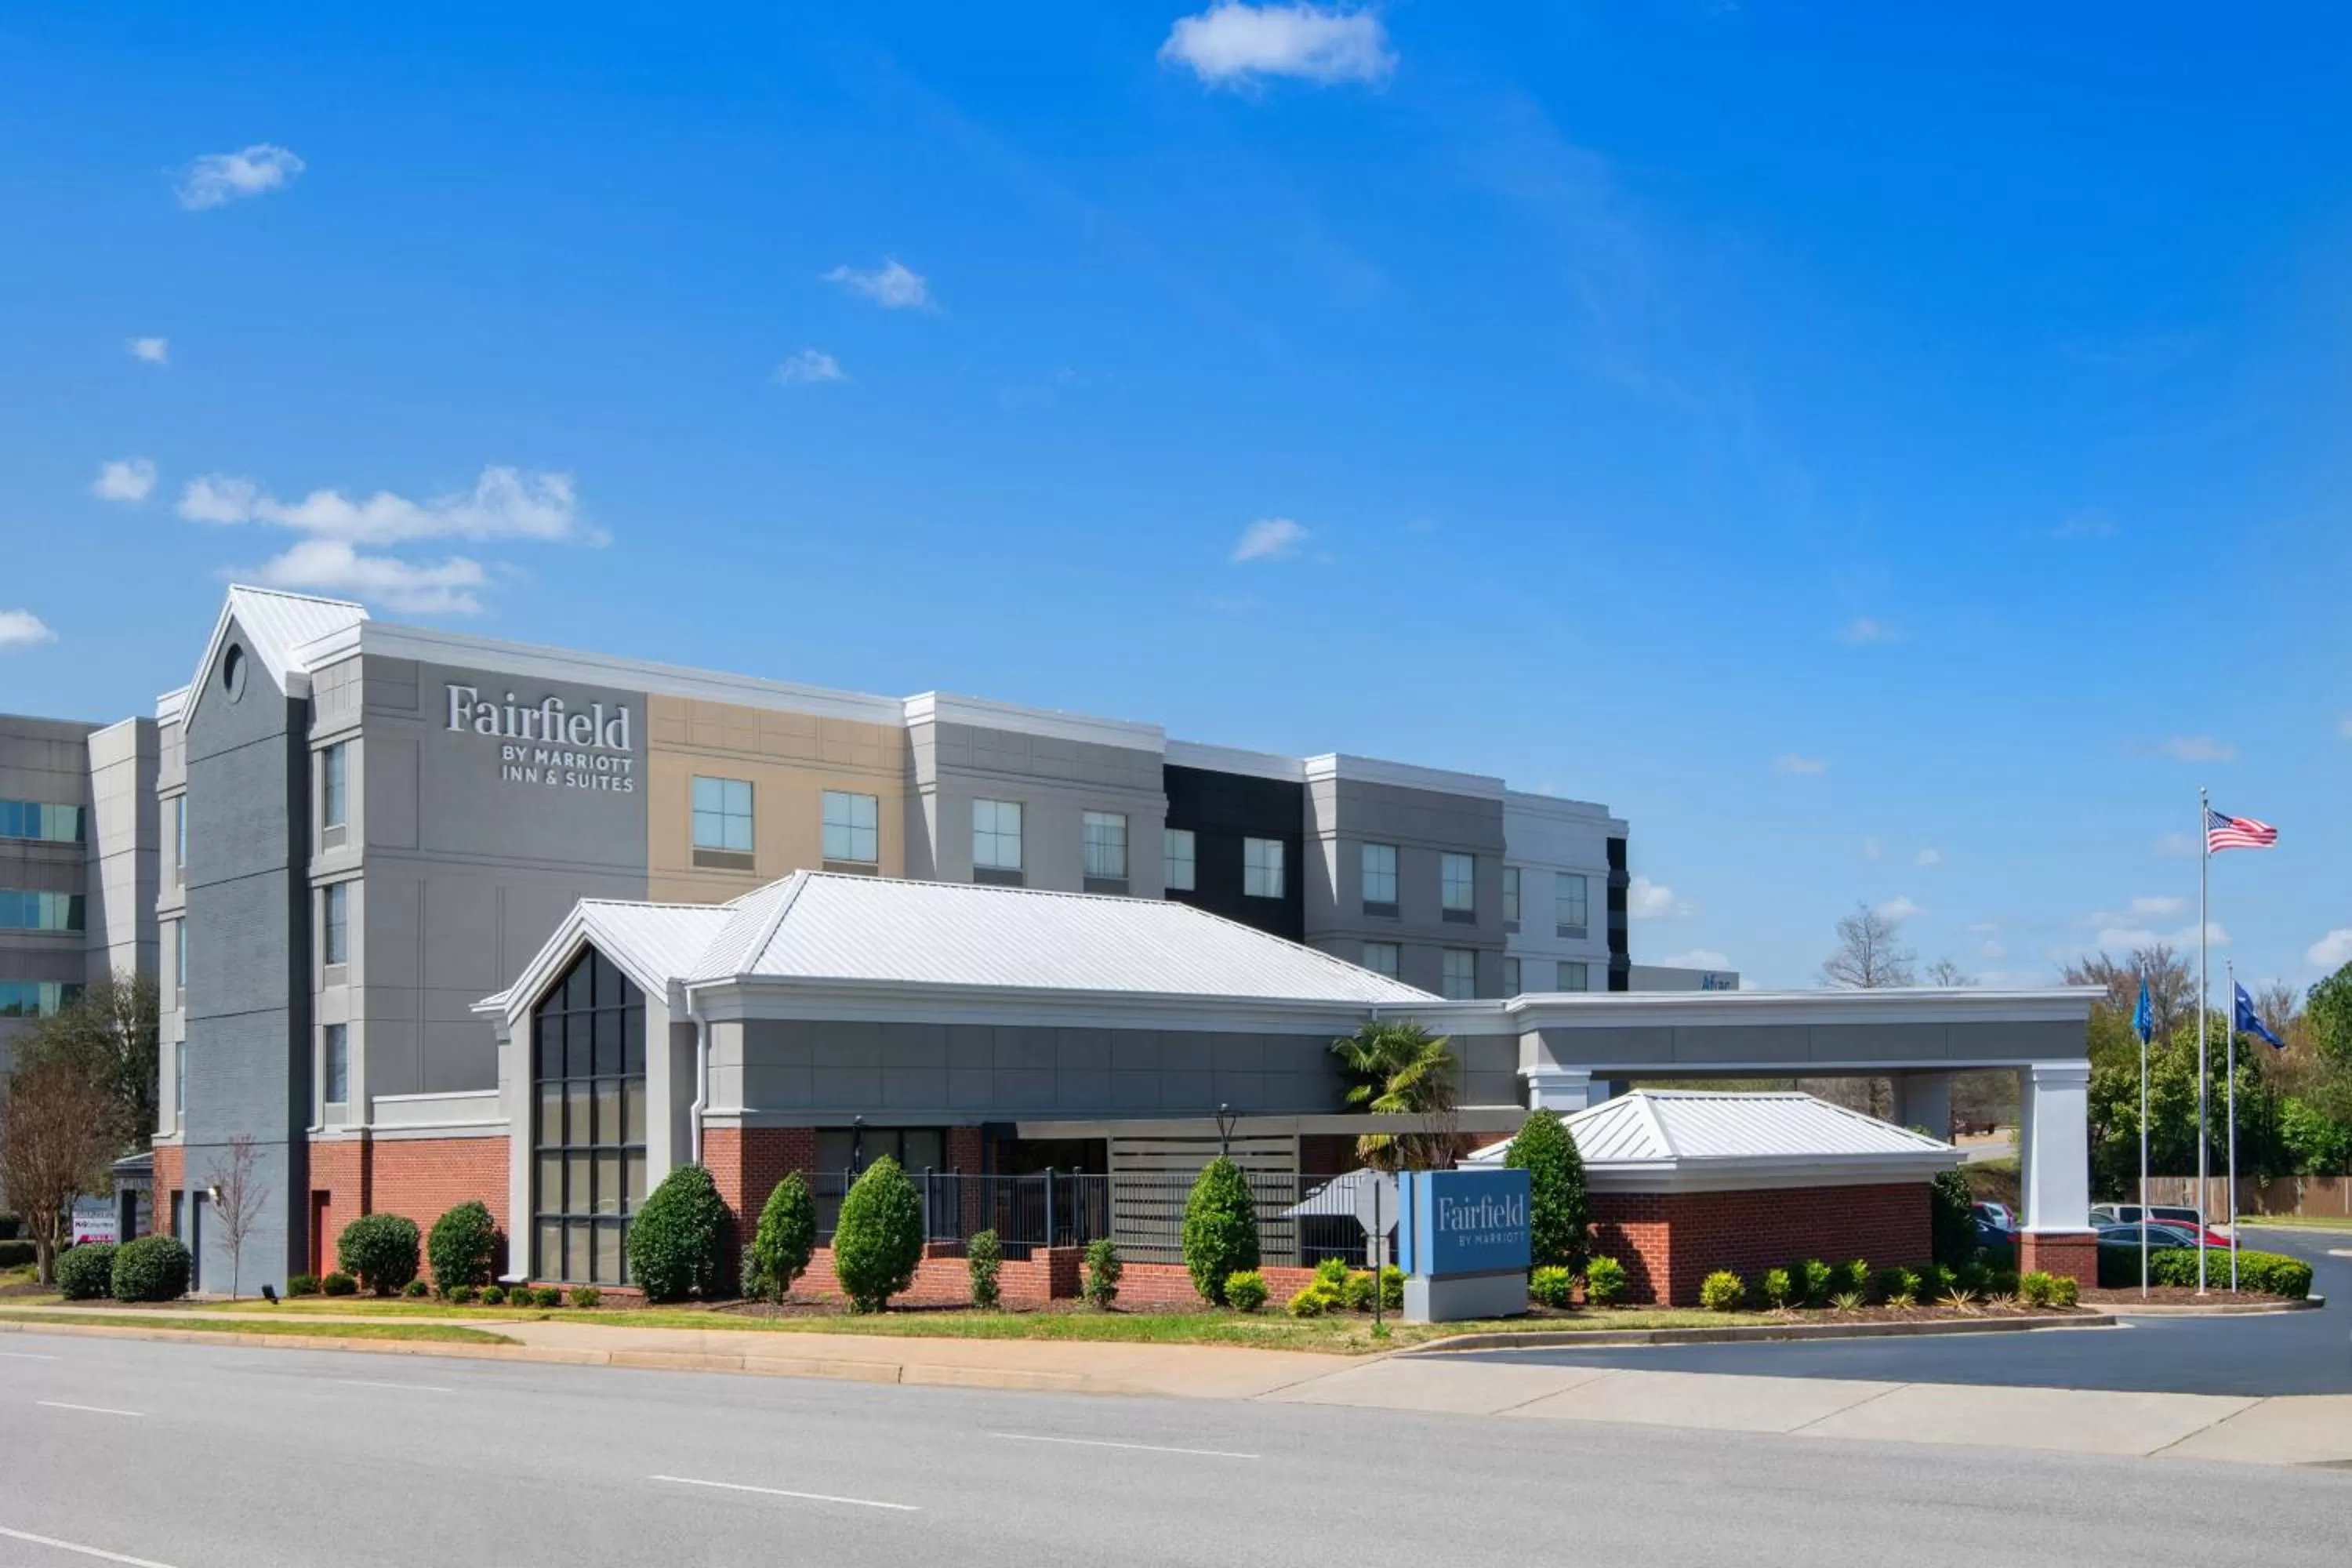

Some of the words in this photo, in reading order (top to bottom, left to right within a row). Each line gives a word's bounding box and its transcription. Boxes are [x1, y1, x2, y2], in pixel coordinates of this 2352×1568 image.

[445, 684, 633, 751] Fairfield
[502, 746, 527, 761] BY
[535, 750, 633, 773] MARRIOTT
[503, 765, 538, 783] INN
[546, 770, 557, 785] &
[565, 773, 633, 793] SUITES
[1439, 1193, 1525, 1232] Fairfield
[1459, 1235, 1471, 1247] BY
[1475, 1232, 1526, 1243] MARRIOTT
